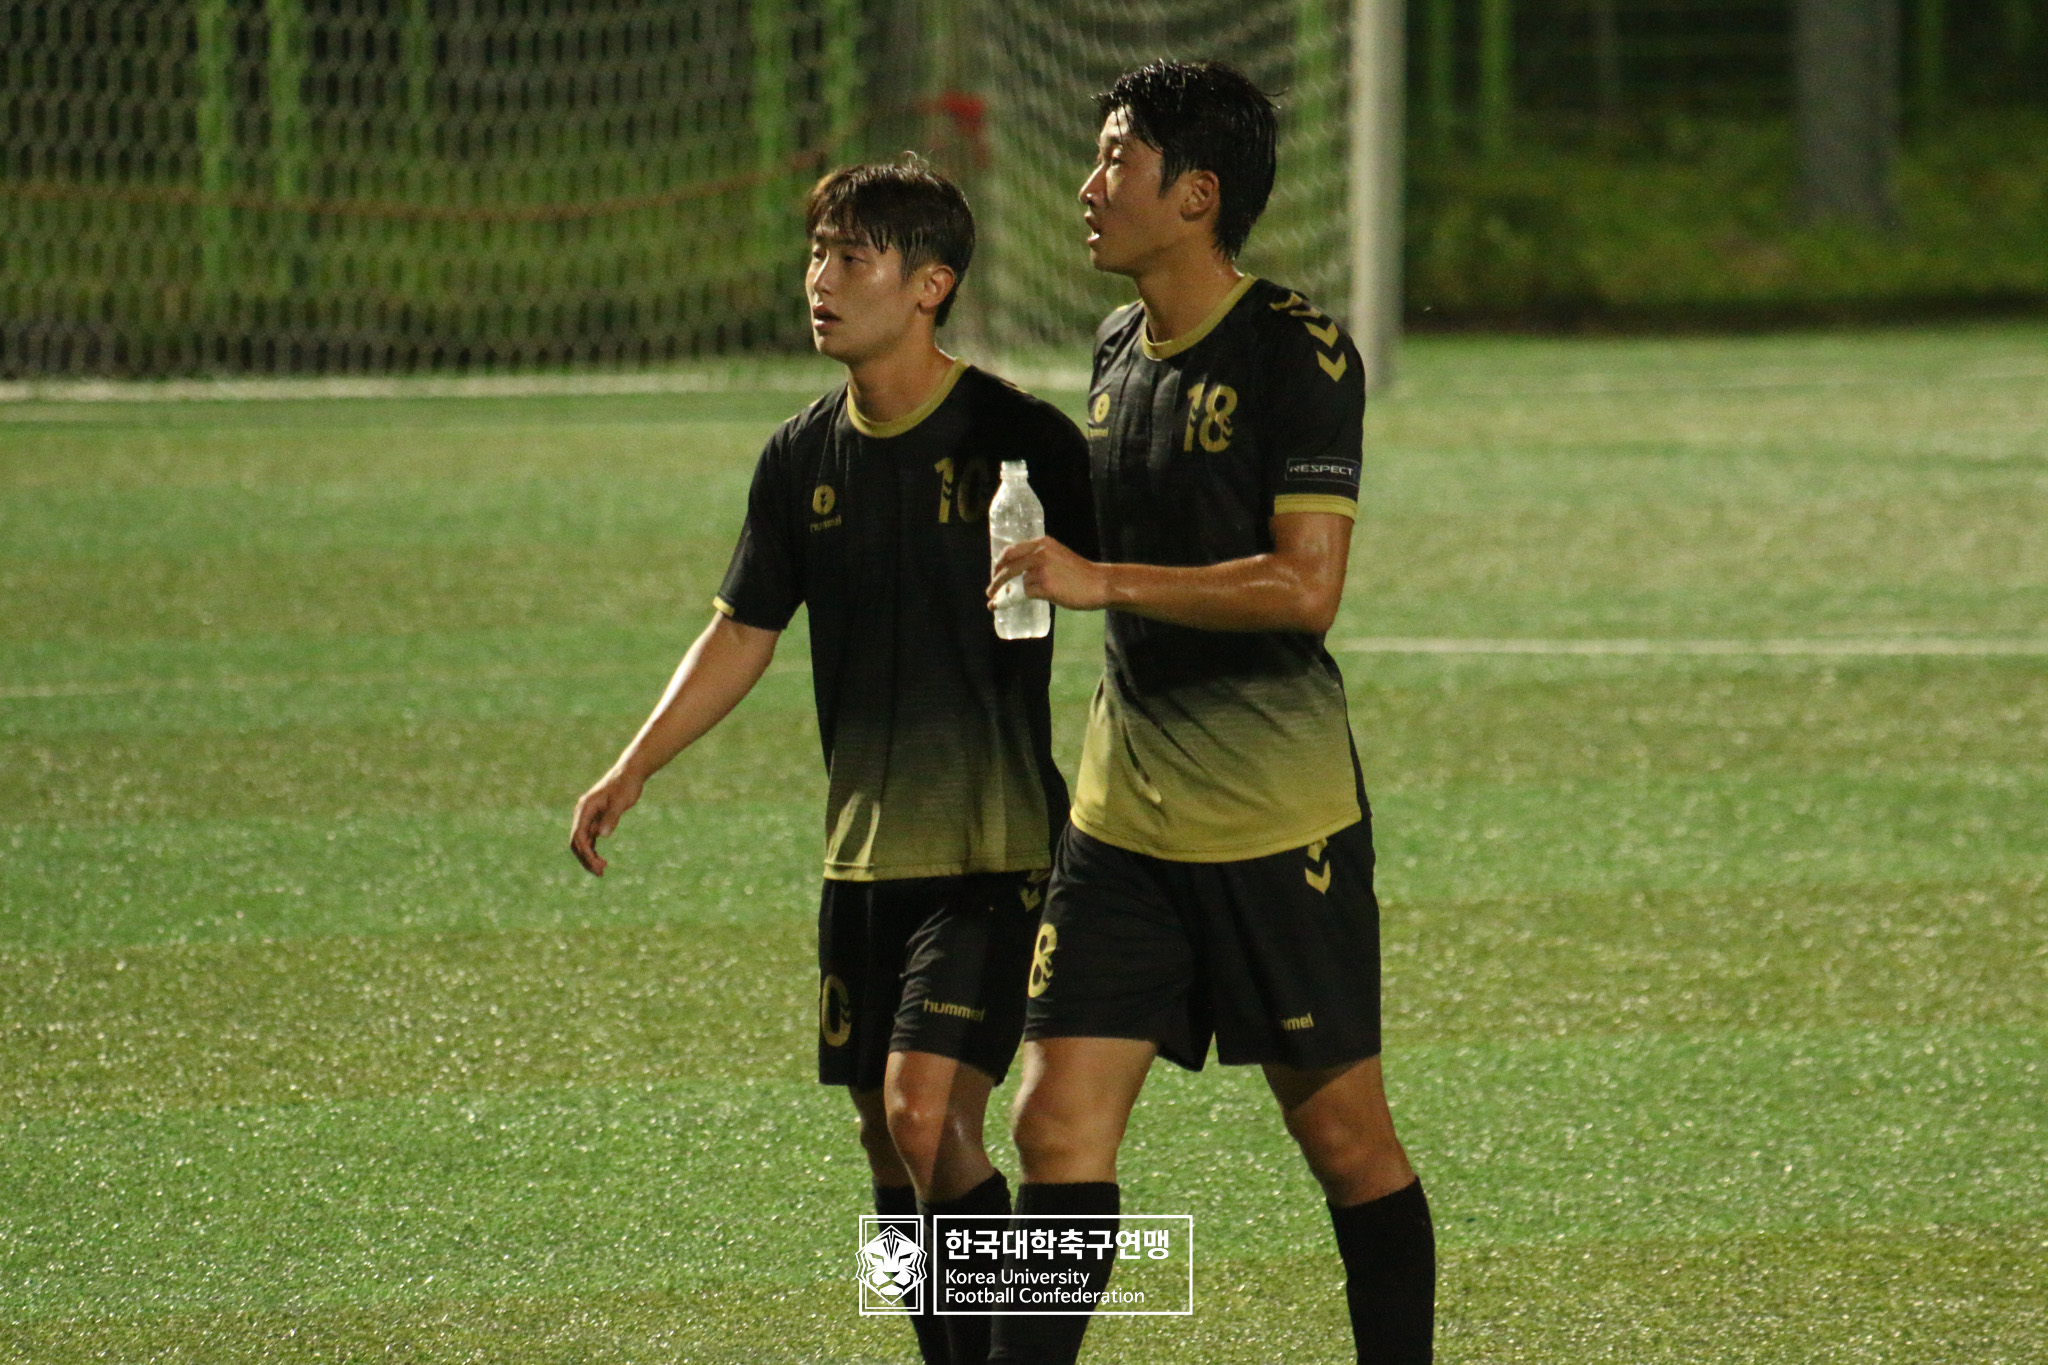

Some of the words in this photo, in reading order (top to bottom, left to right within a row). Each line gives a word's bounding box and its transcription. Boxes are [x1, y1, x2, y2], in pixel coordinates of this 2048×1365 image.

[1183, 382, 1238, 452] 18
[934, 457, 990, 524] 10
[1289, 464, 1354, 476] RESPECT
[923, 998, 985, 1022] hummel
